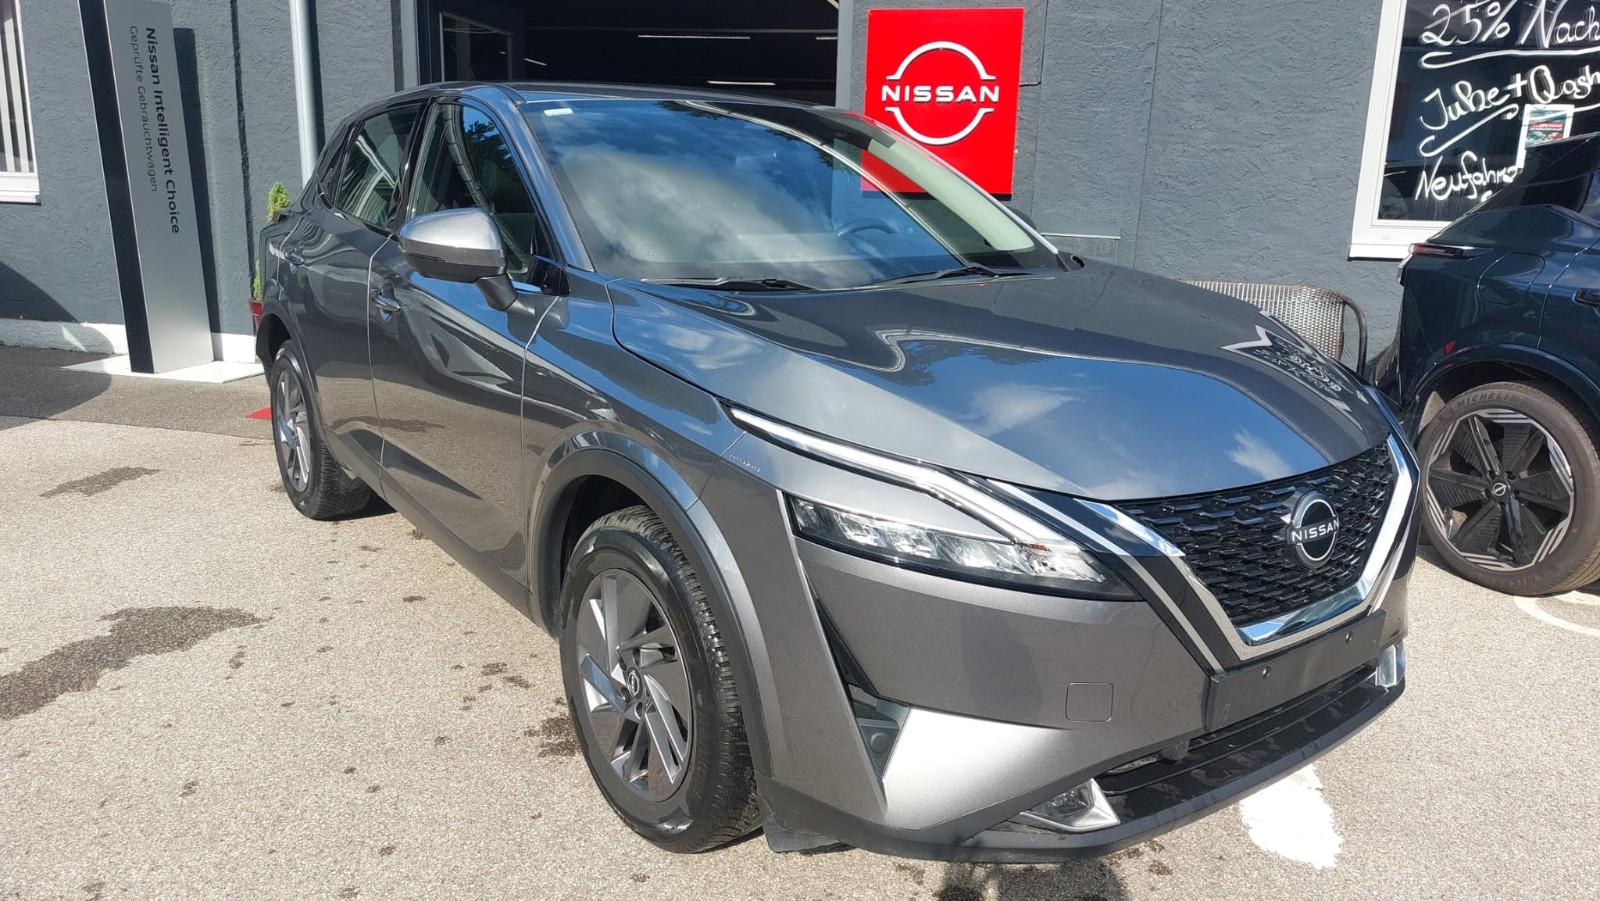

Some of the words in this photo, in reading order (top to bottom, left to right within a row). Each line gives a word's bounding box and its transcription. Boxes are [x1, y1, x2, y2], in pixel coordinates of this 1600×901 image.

[1421, 0, 1516, 46] 25%
[130, 25, 145, 82] Geprüfte
[146, 27, 161, 86] Nissan
[881, 85, 1000, 103] NISSAN
[137, 86, 158, 192] Gebrauchtwagen
[153, 90, 173, 176] Intelligent
[166, 179, 179, 234] Choice
[1291, 519, 1340, 542] NISSAN
